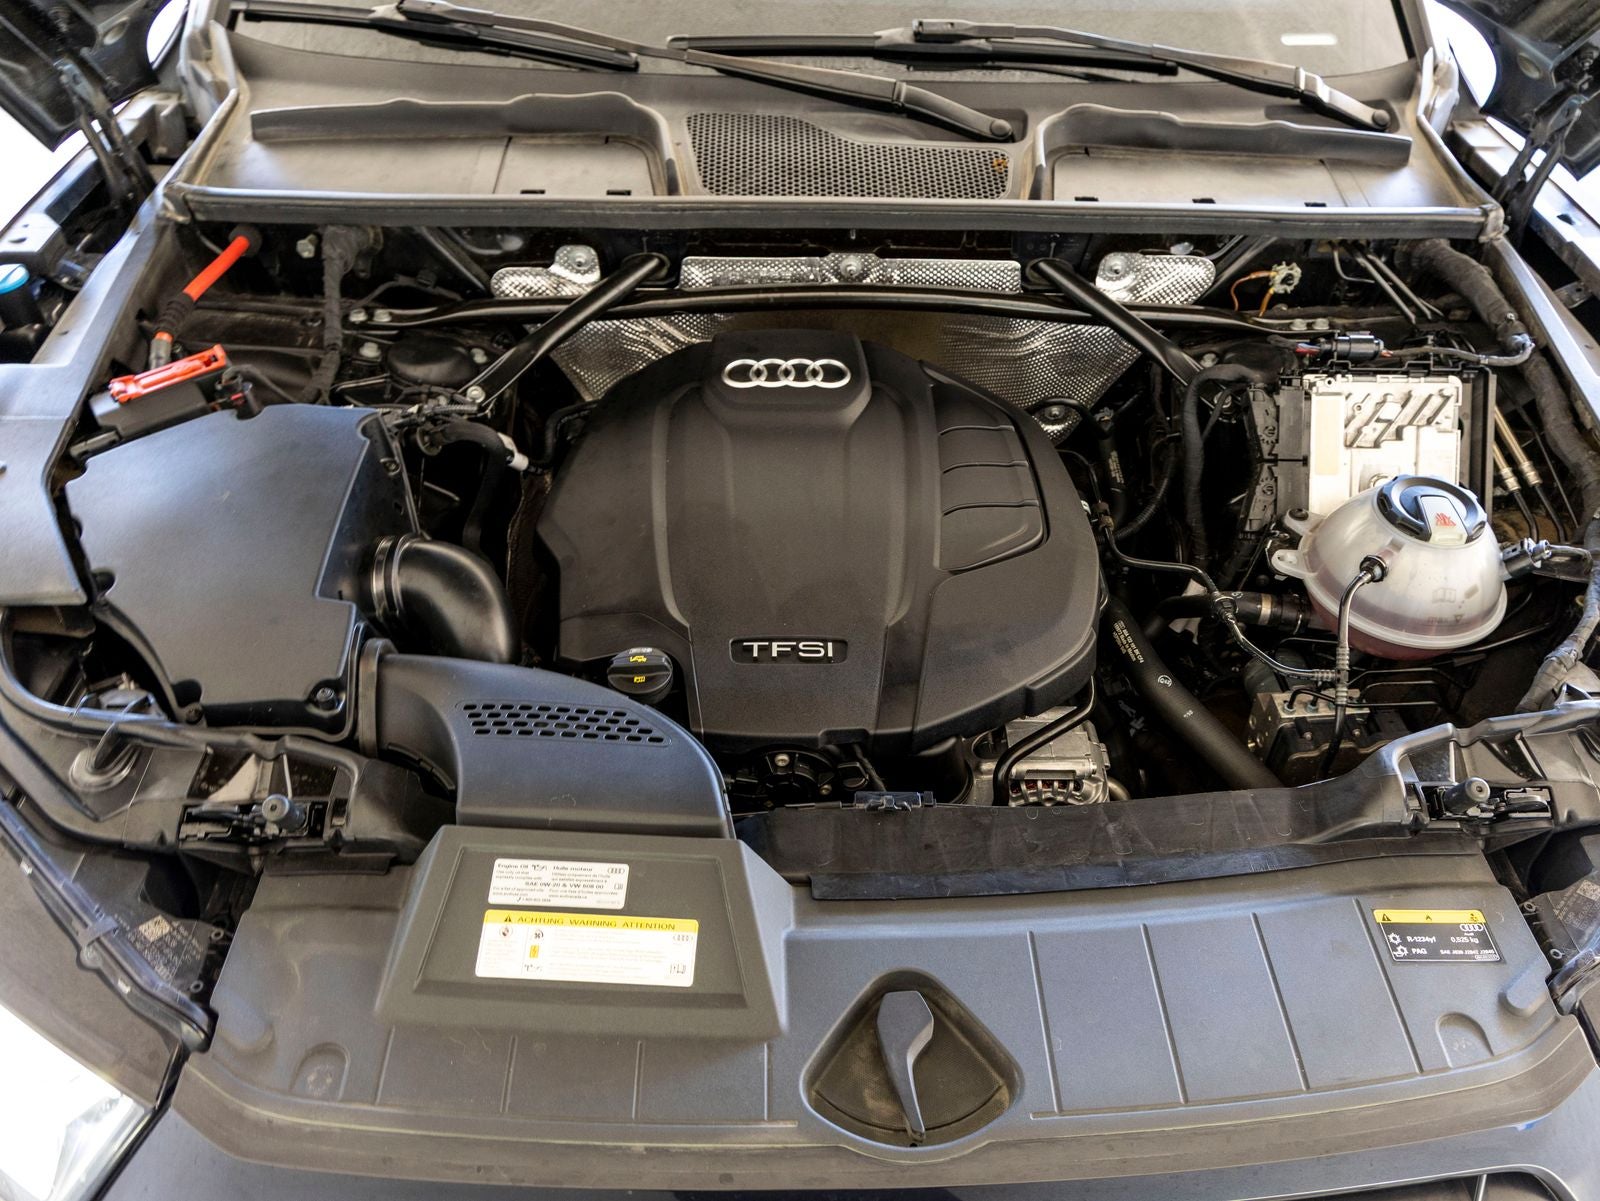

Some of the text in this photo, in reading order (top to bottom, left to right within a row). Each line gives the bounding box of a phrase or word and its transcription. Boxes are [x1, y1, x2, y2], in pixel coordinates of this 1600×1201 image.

[742, 642, 834, 658] TFSI
[517, 916, 676, 930] ACHTUNG WARNING ATTENTION
